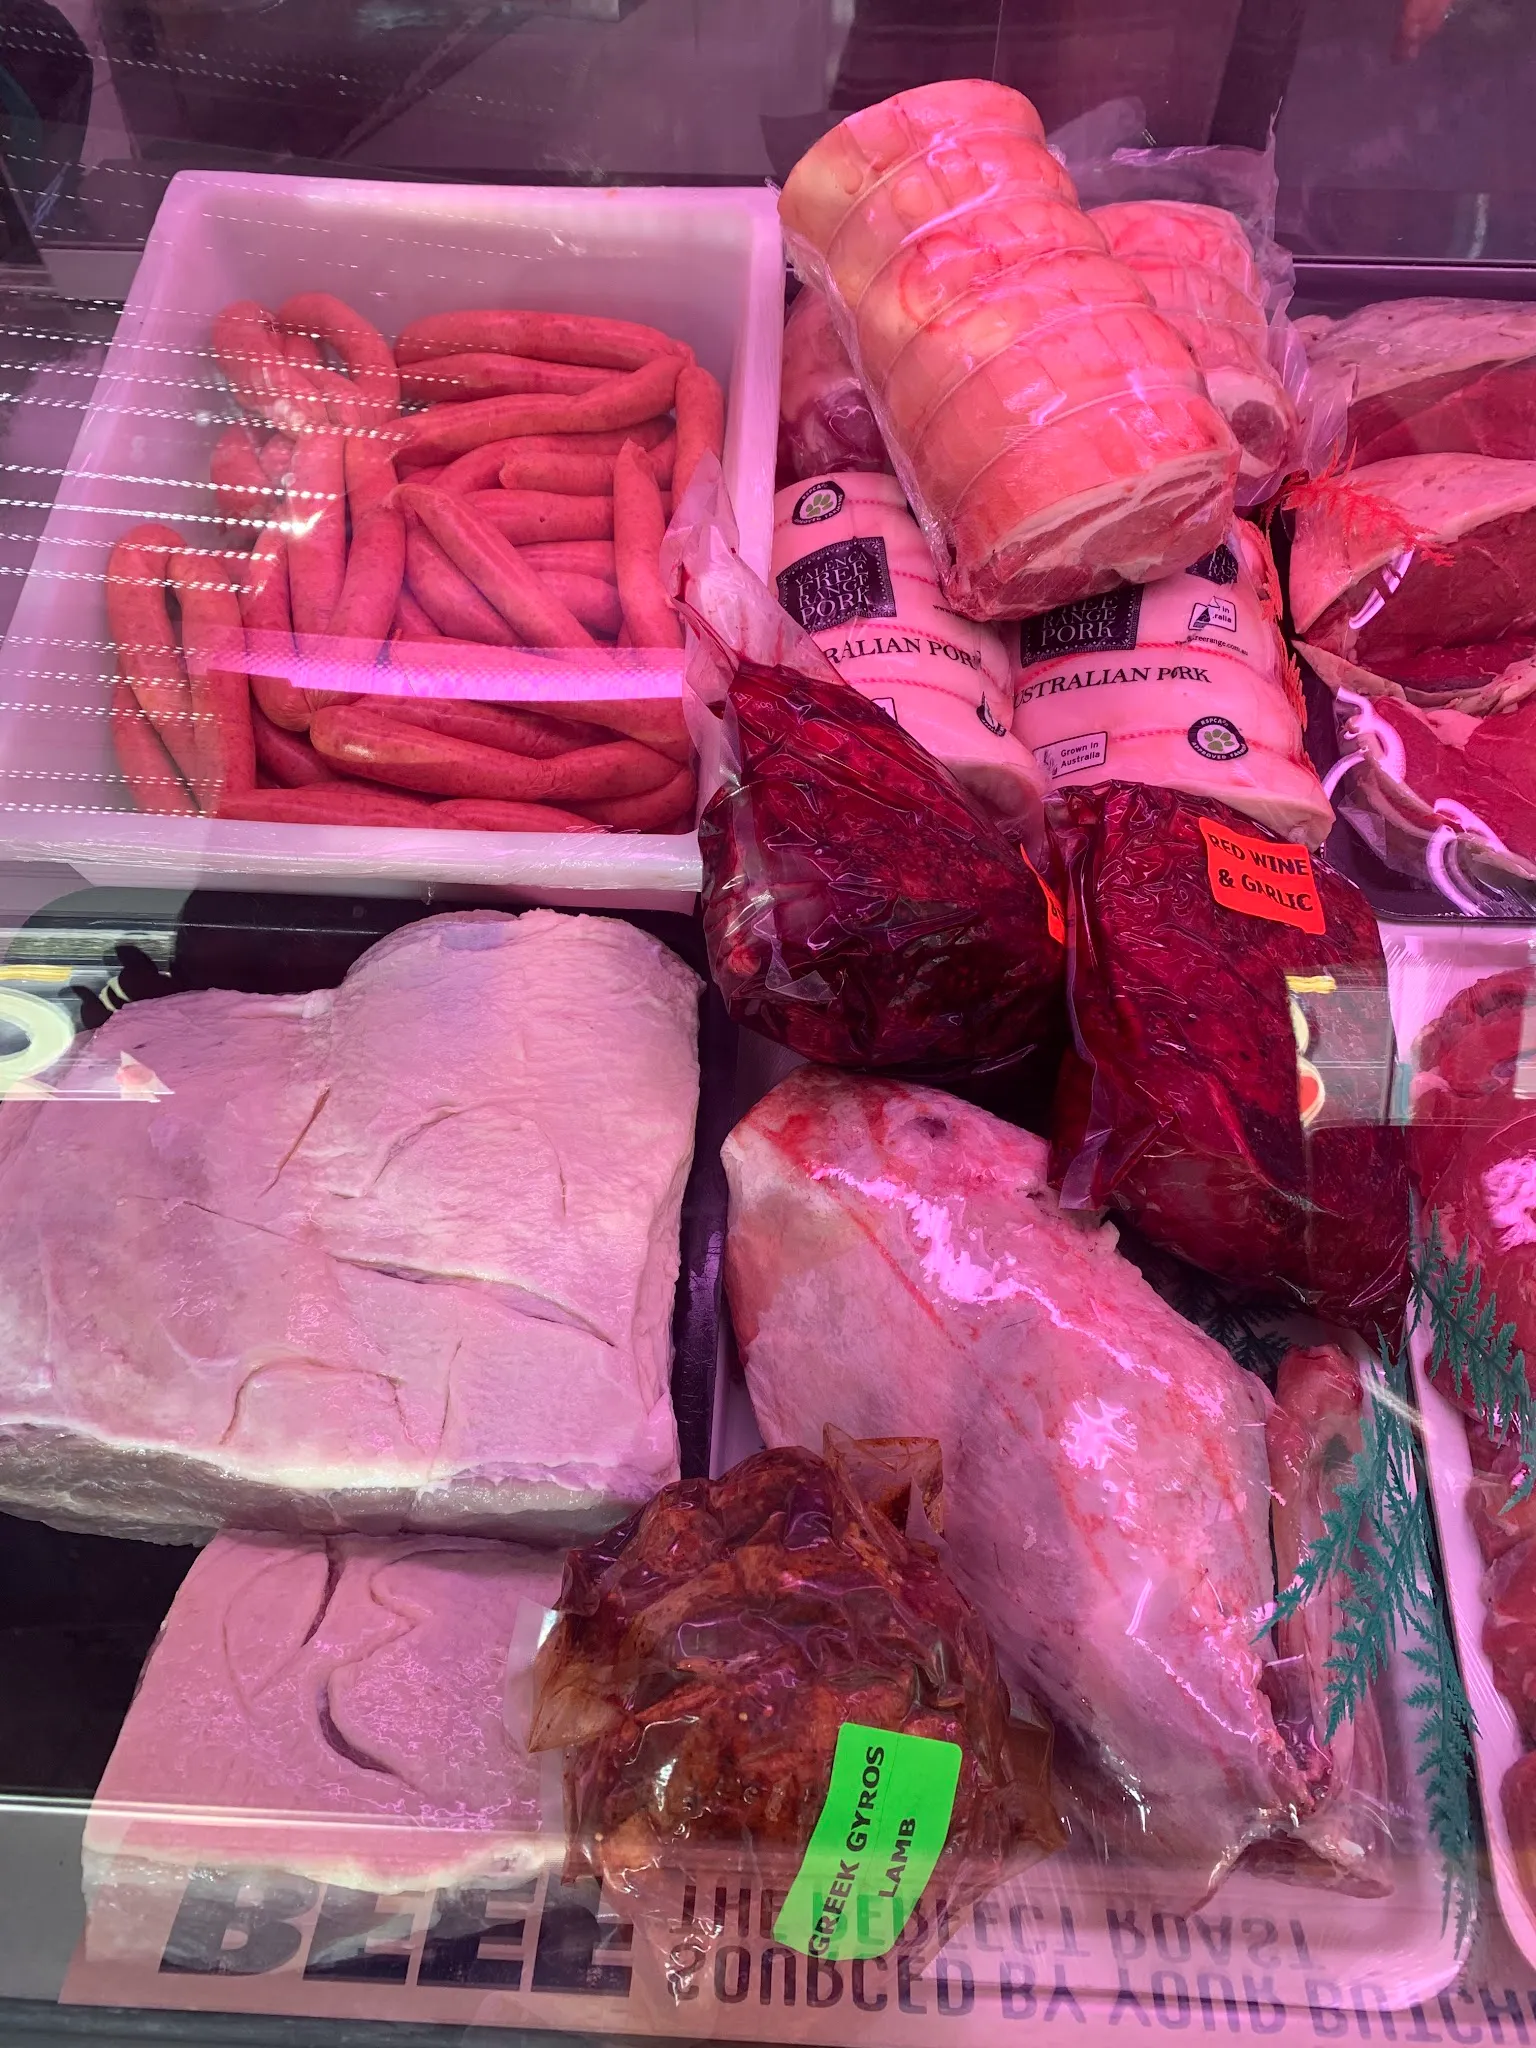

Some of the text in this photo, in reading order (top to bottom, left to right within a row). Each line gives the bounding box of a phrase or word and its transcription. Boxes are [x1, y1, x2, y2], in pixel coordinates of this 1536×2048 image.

[799, 561, 869, 597] FREE
[799, 575, 870, 608] RANGE
[801, 587, 871, 626] PORK
[1043, 608, 1117, 629] RANGE
[824, 637, 921, 665] RALIAN
[1041, 621, 1114, 647] PORK
[1013, 667, 1152, 709] USTRALIAN
[1060, 744, 1088, 758] Grown
[1060, 751, 1101, 769] Australia
[1207, 833, 1310, 876] RED WINE
[1218, 868, 1314, 912] & GARLIC
[807, 1746, 885, 1957] GREEK GYROS
[878, 1817, 916, 1898] LAMB
